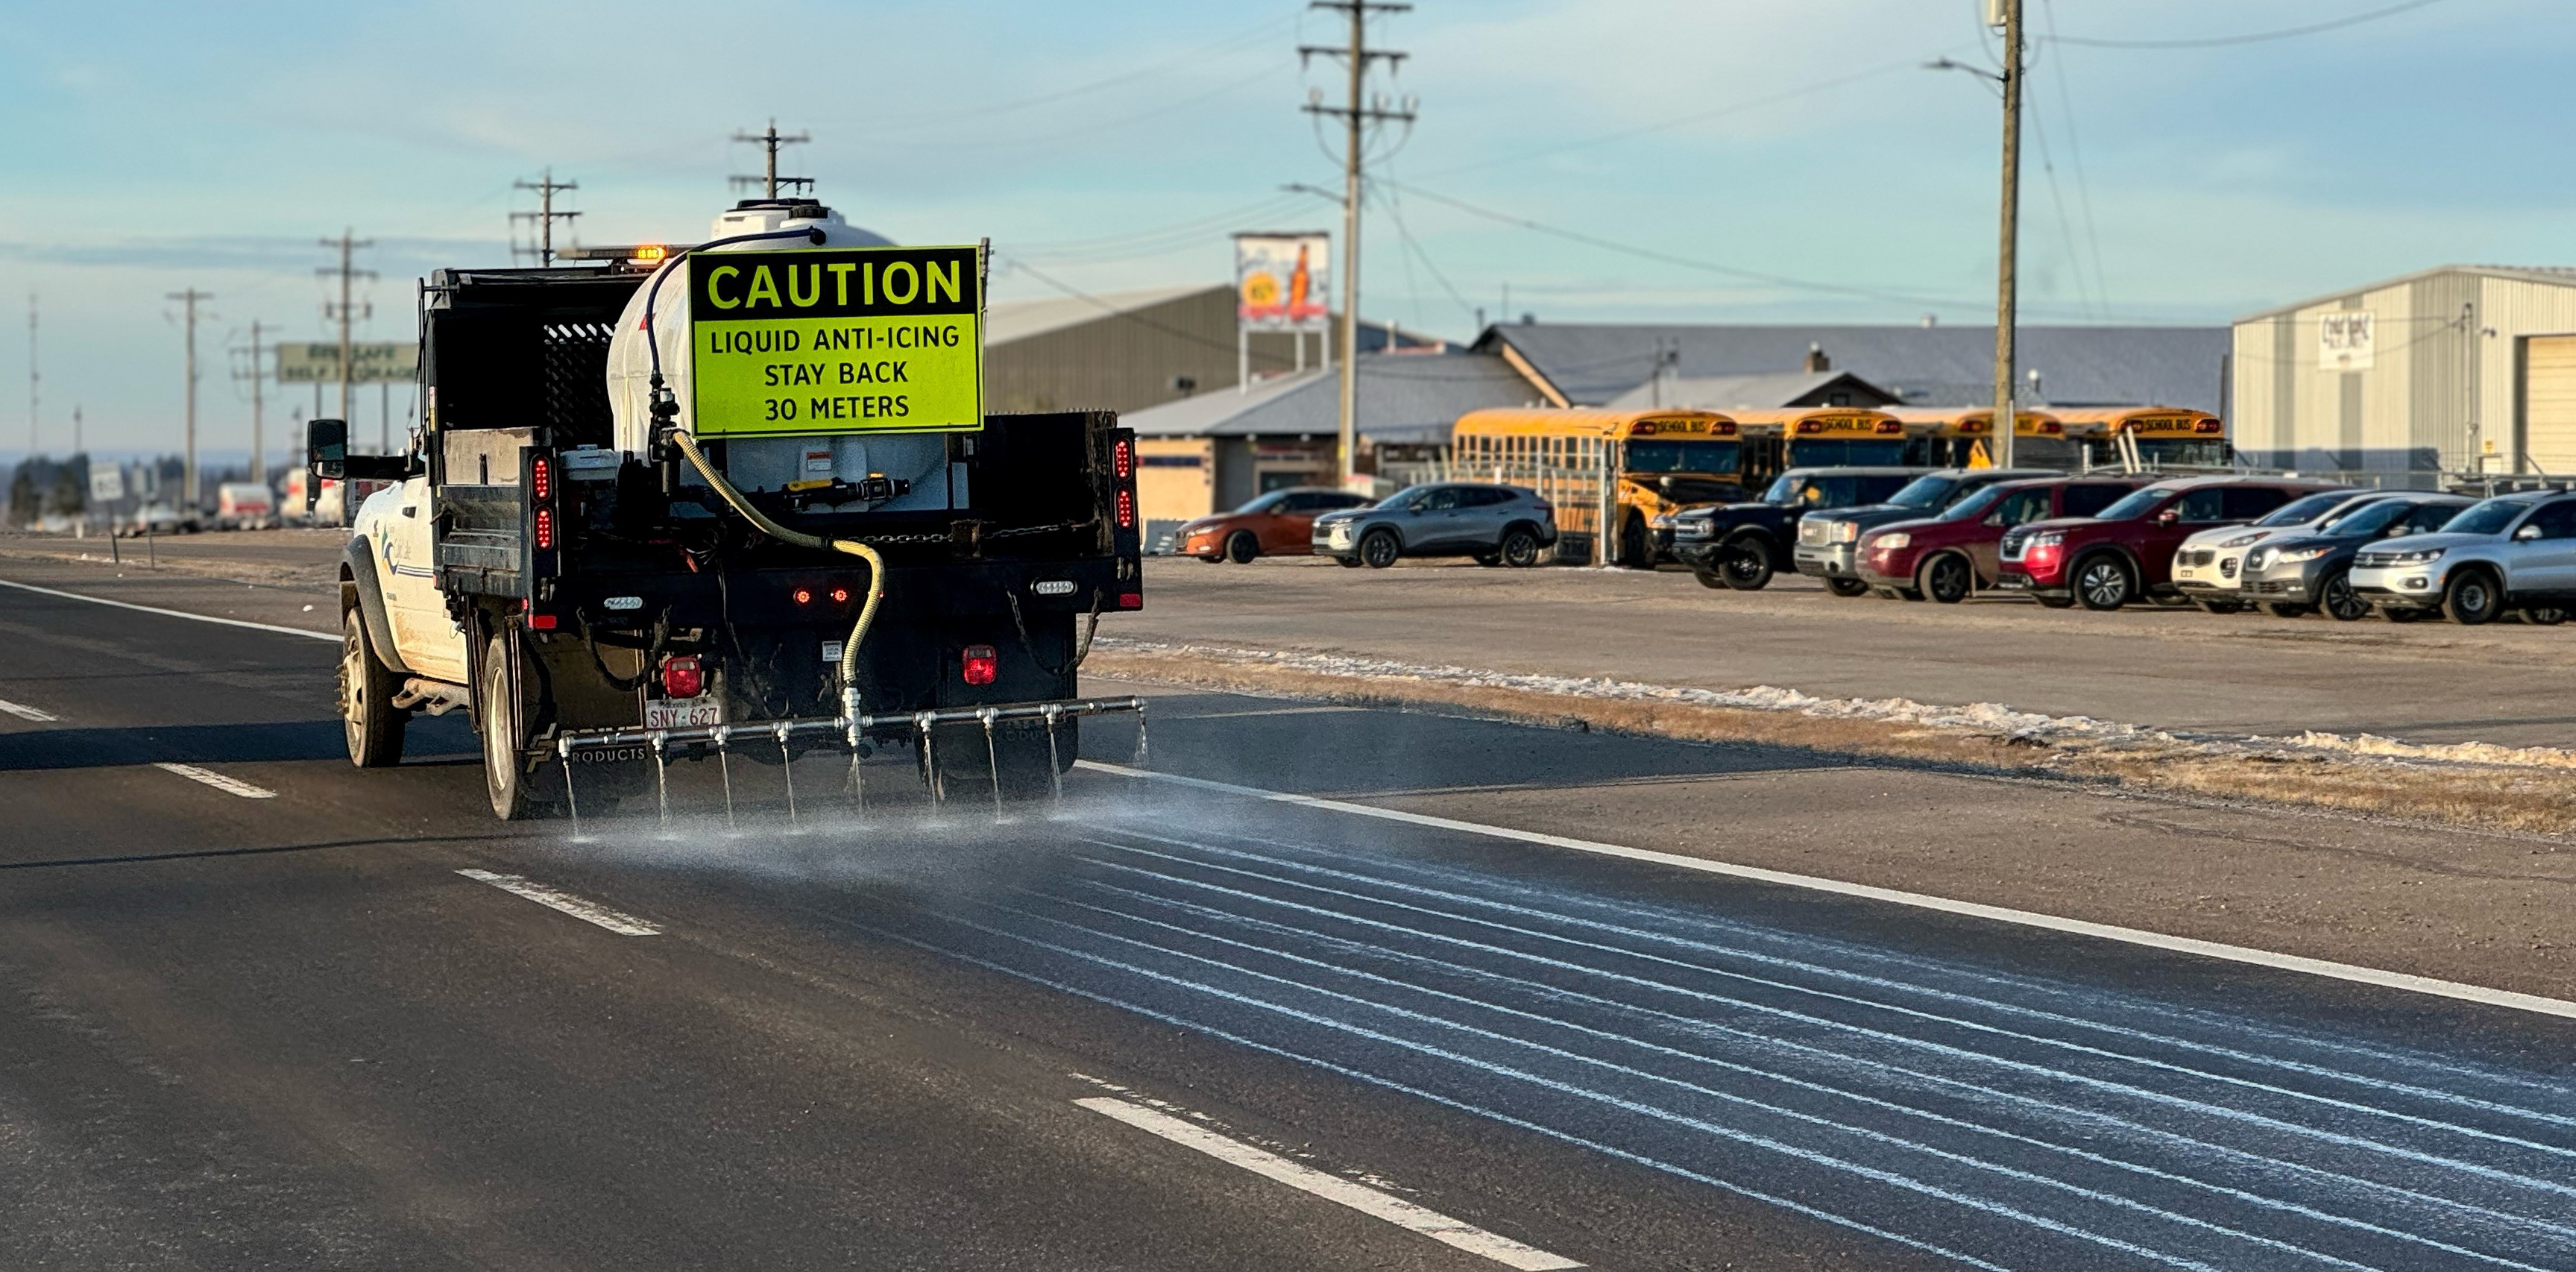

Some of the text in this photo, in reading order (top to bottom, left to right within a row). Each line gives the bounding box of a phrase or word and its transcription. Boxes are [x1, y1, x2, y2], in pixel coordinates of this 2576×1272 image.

[708, 259, 960, 309] CAUTION
[711, 325, 960, 354] LIQUID ANTI-ICING
[765, 361, 908, 386] STAY BACK
[765, 395, 909, 421] 30 METERS
[1657, 420, 1707, 433] SCHOOL BUS
[1825, 418, 1872, 430] SCHOOL BUS
[2144, 418, 2191, 431] SCHOOL BUS
[572, 748, 645, 763] RODUCTS
